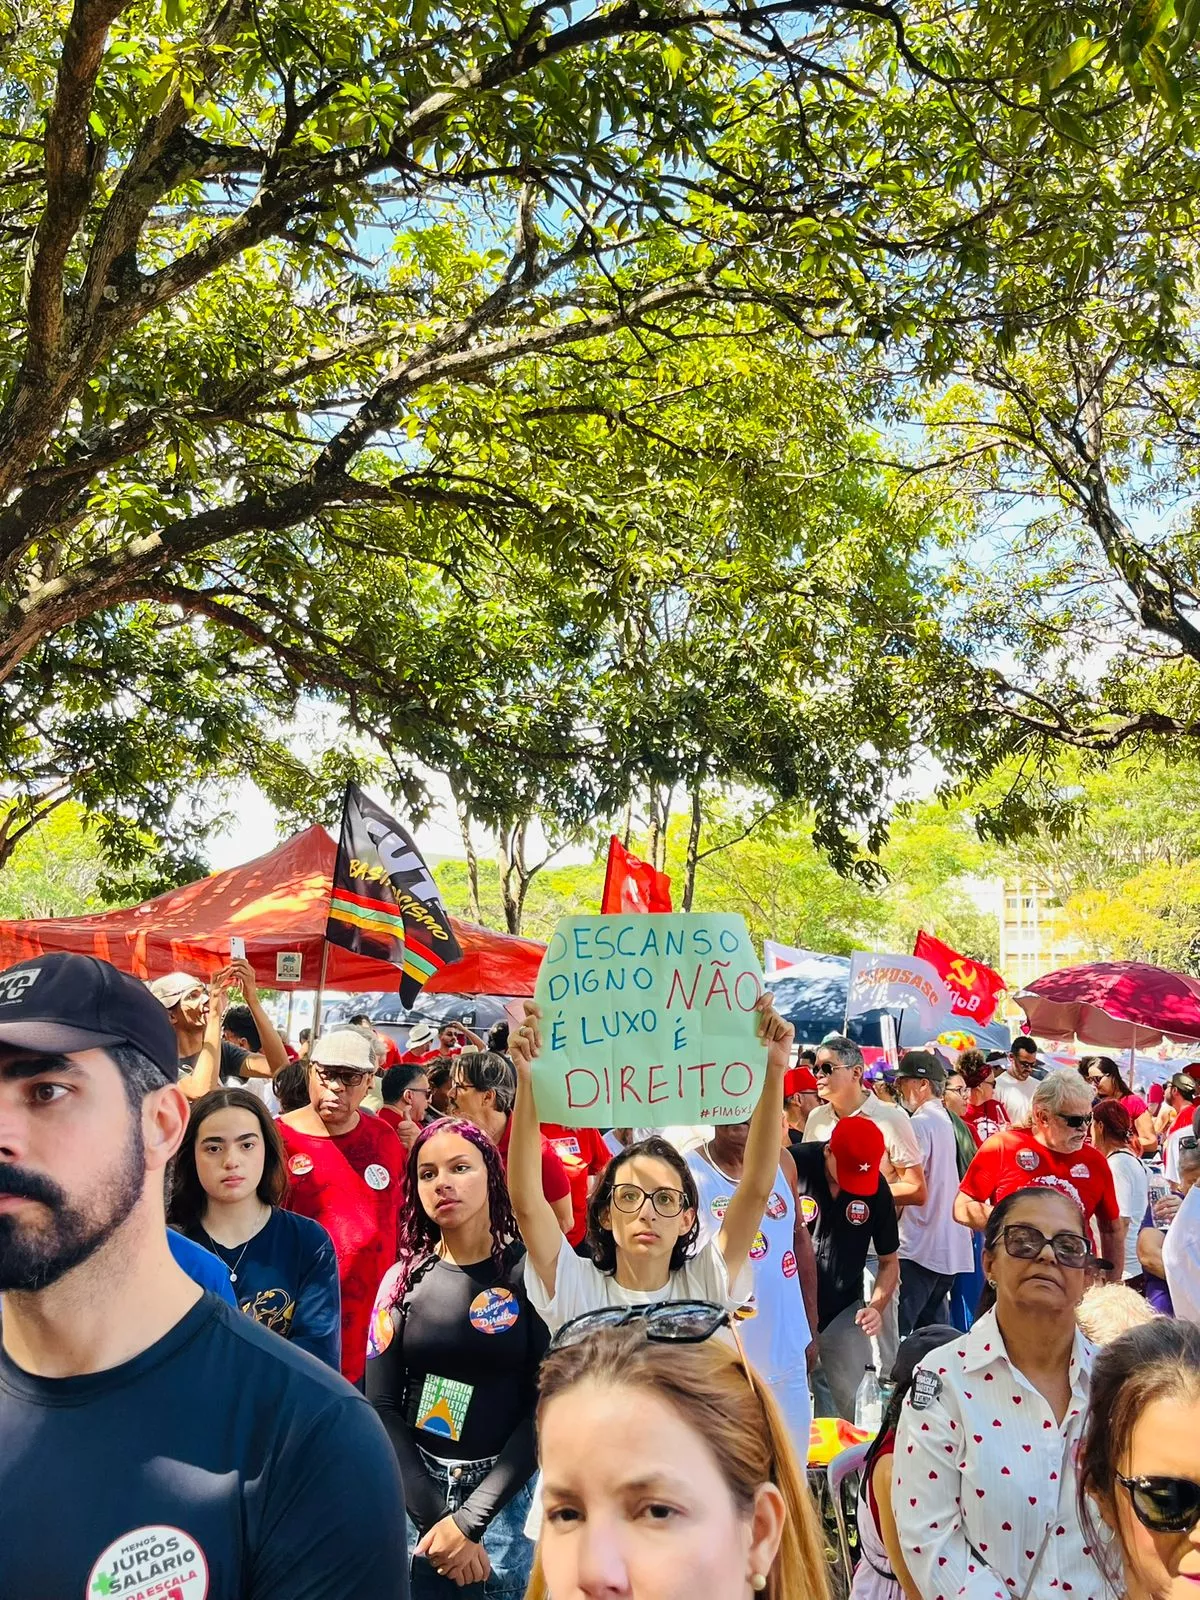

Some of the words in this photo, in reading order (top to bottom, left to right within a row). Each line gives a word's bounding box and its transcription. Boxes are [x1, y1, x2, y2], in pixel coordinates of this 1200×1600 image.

[547, 925, 739, 964] DESCANSO
[548, 967, 653, 1001] DIGNO
[666, 960, 762, 1013] NÃO
[551, 1011, 568, 1051] É
[581, 1009, 657, 1044] LUXO
[673, 1017, 688, 1050] É
[565, 1061, 753, 1108] DIREITO
[421, 1391, 436, 1402] SEM
[423, 1382, 438, 1394] SEM
[425, 1373, 440, 1385] SEM
[441, 1378, 474, 1396] ANISTIA
[110, 1537, 180, 1576] JUROS
[121, 1535, 157, 1555] MENOS
[108, 1549, 196, 1594] SALÁRIO
[146, 1570, 198, 1597] ESCALA
